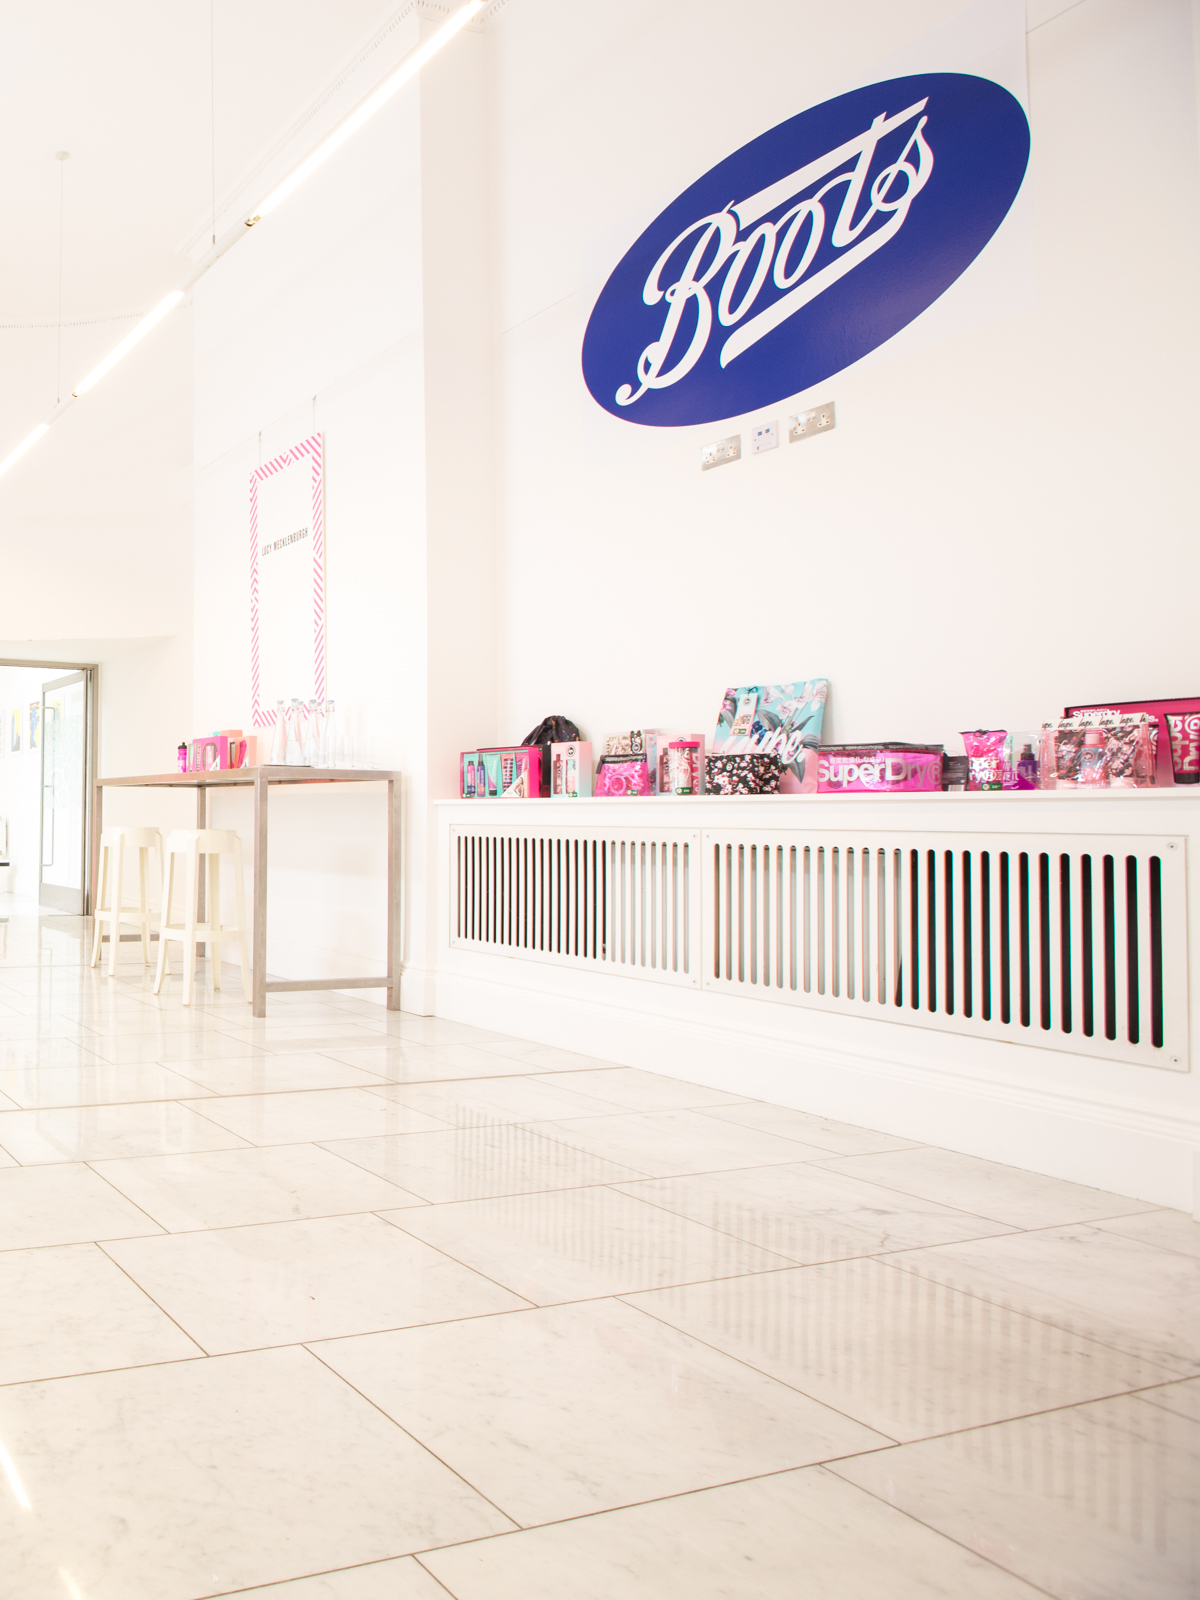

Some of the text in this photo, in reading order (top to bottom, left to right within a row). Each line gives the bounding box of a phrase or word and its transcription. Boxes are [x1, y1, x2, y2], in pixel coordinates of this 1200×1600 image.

[615, 96, 935, 407] Boots
[261, 527, 309, 557] LUCY MECKLENBURGH
